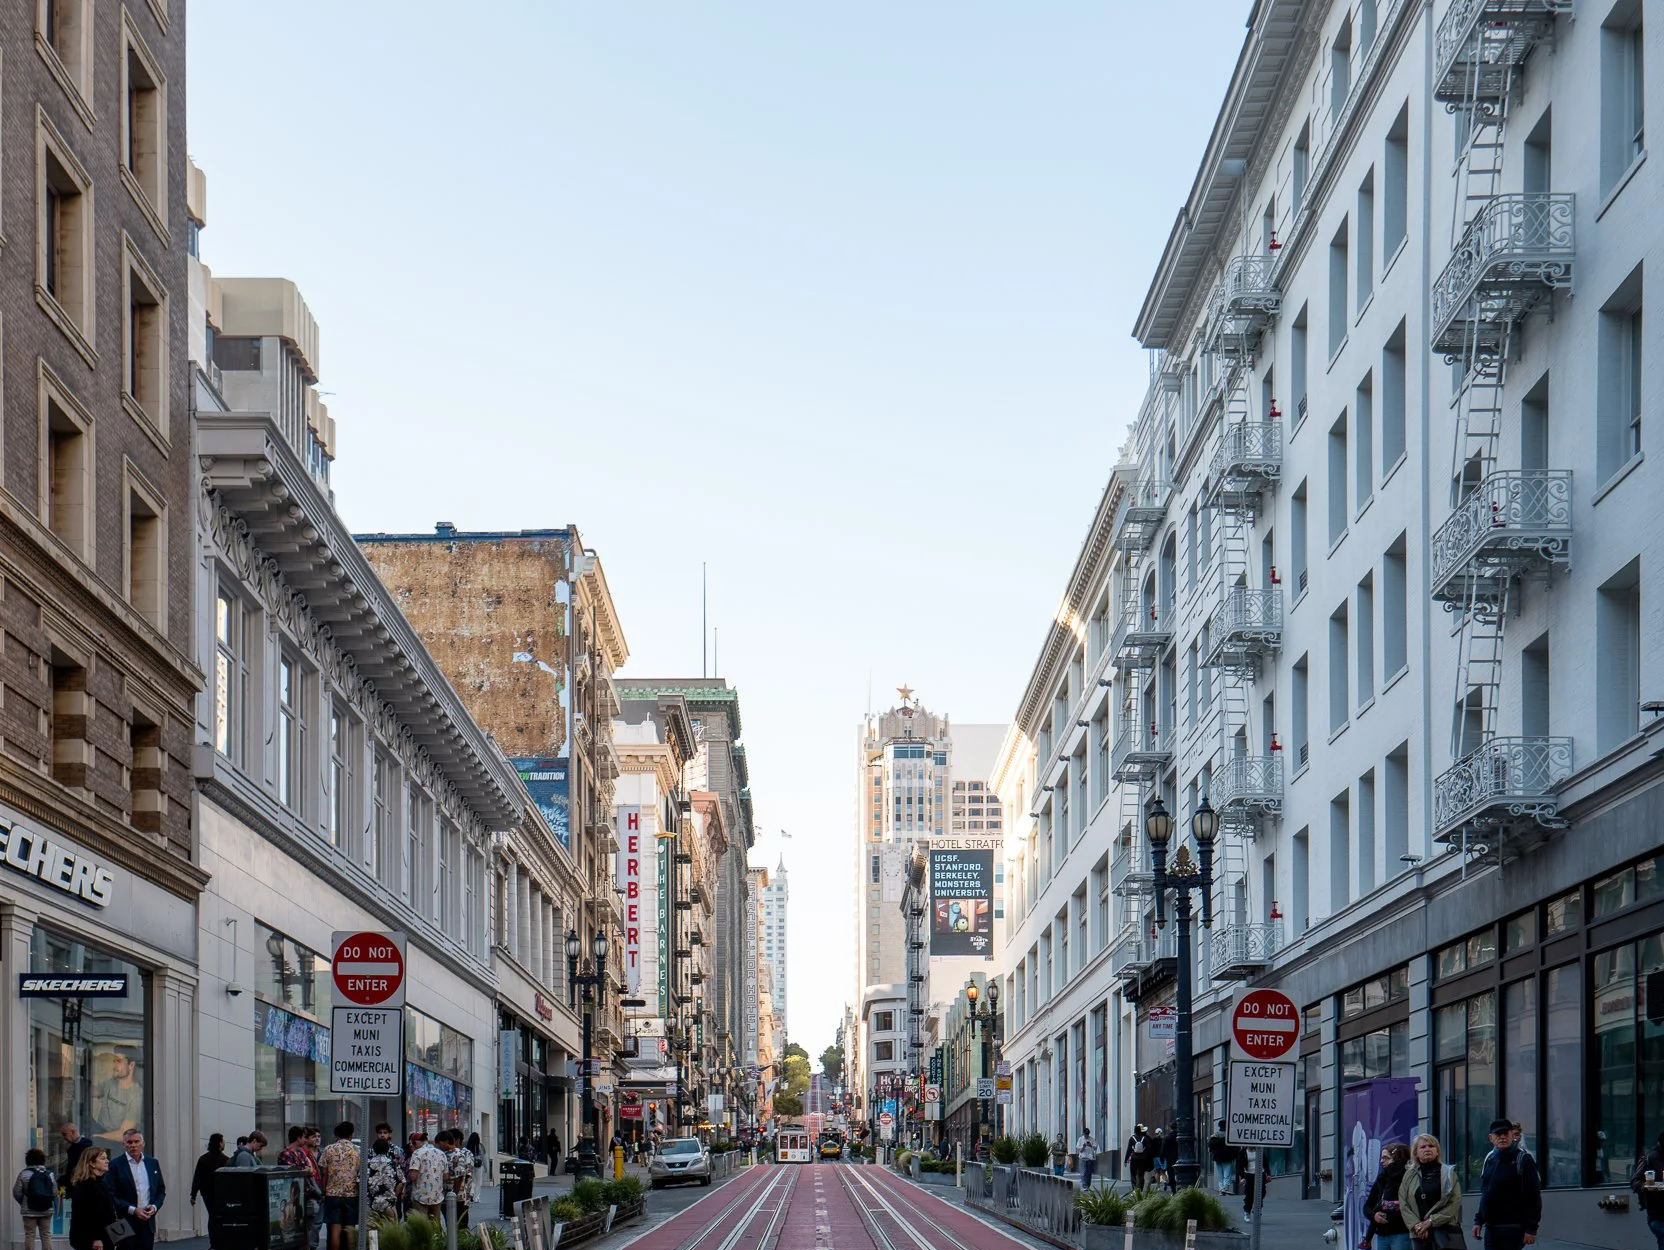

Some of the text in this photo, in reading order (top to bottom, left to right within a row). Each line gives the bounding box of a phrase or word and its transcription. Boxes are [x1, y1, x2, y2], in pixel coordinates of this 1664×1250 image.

[931, 839, 962, 849] HOTEL
[934, 854, 960, 862] UCSF.
[934, 863, 984, 871] STANFORD.
[658, 859, 666, 899] THE
[934, 880, 981, 888] MONSTERS
[627, 812, 639, 968] HERBERT
[934, 889, 988, 897] UNIVERSITY.
[343, 946, 393, 959] DO NOT
[658, 909, 667, 996] BARNES
[21, 979, 125, 991] SKECHERS
[347, 979, 388, 991] ENTER
[746, 984, 756, 1033] HOTEL
[1243, 1002, 1291, 1016] DO NOT
[346, 1012, 387, 1025] EXCEPT
[353, 1029, 380, 1041] MUNI
[1246, 1034, 1284, 1047] ENTER
[351, 1045, 382, 1057] TAXIS
[334, 1060, 397, 1074] COMMERCIAL
[1244, 1066, 1283, 1078] EXCEPT
[339, 1077, 391, 1090] VEHICLES
[1250, 1082, 1276, 1094] MUNI
[978, 1088, 992, 1097] 20
[1248, 1098, 1277, 1110] TAXIS
[1231, 1112, 1290, 1126] COMMERCIAL
[1236, 1128, 1285, 1141] VEHICLES
